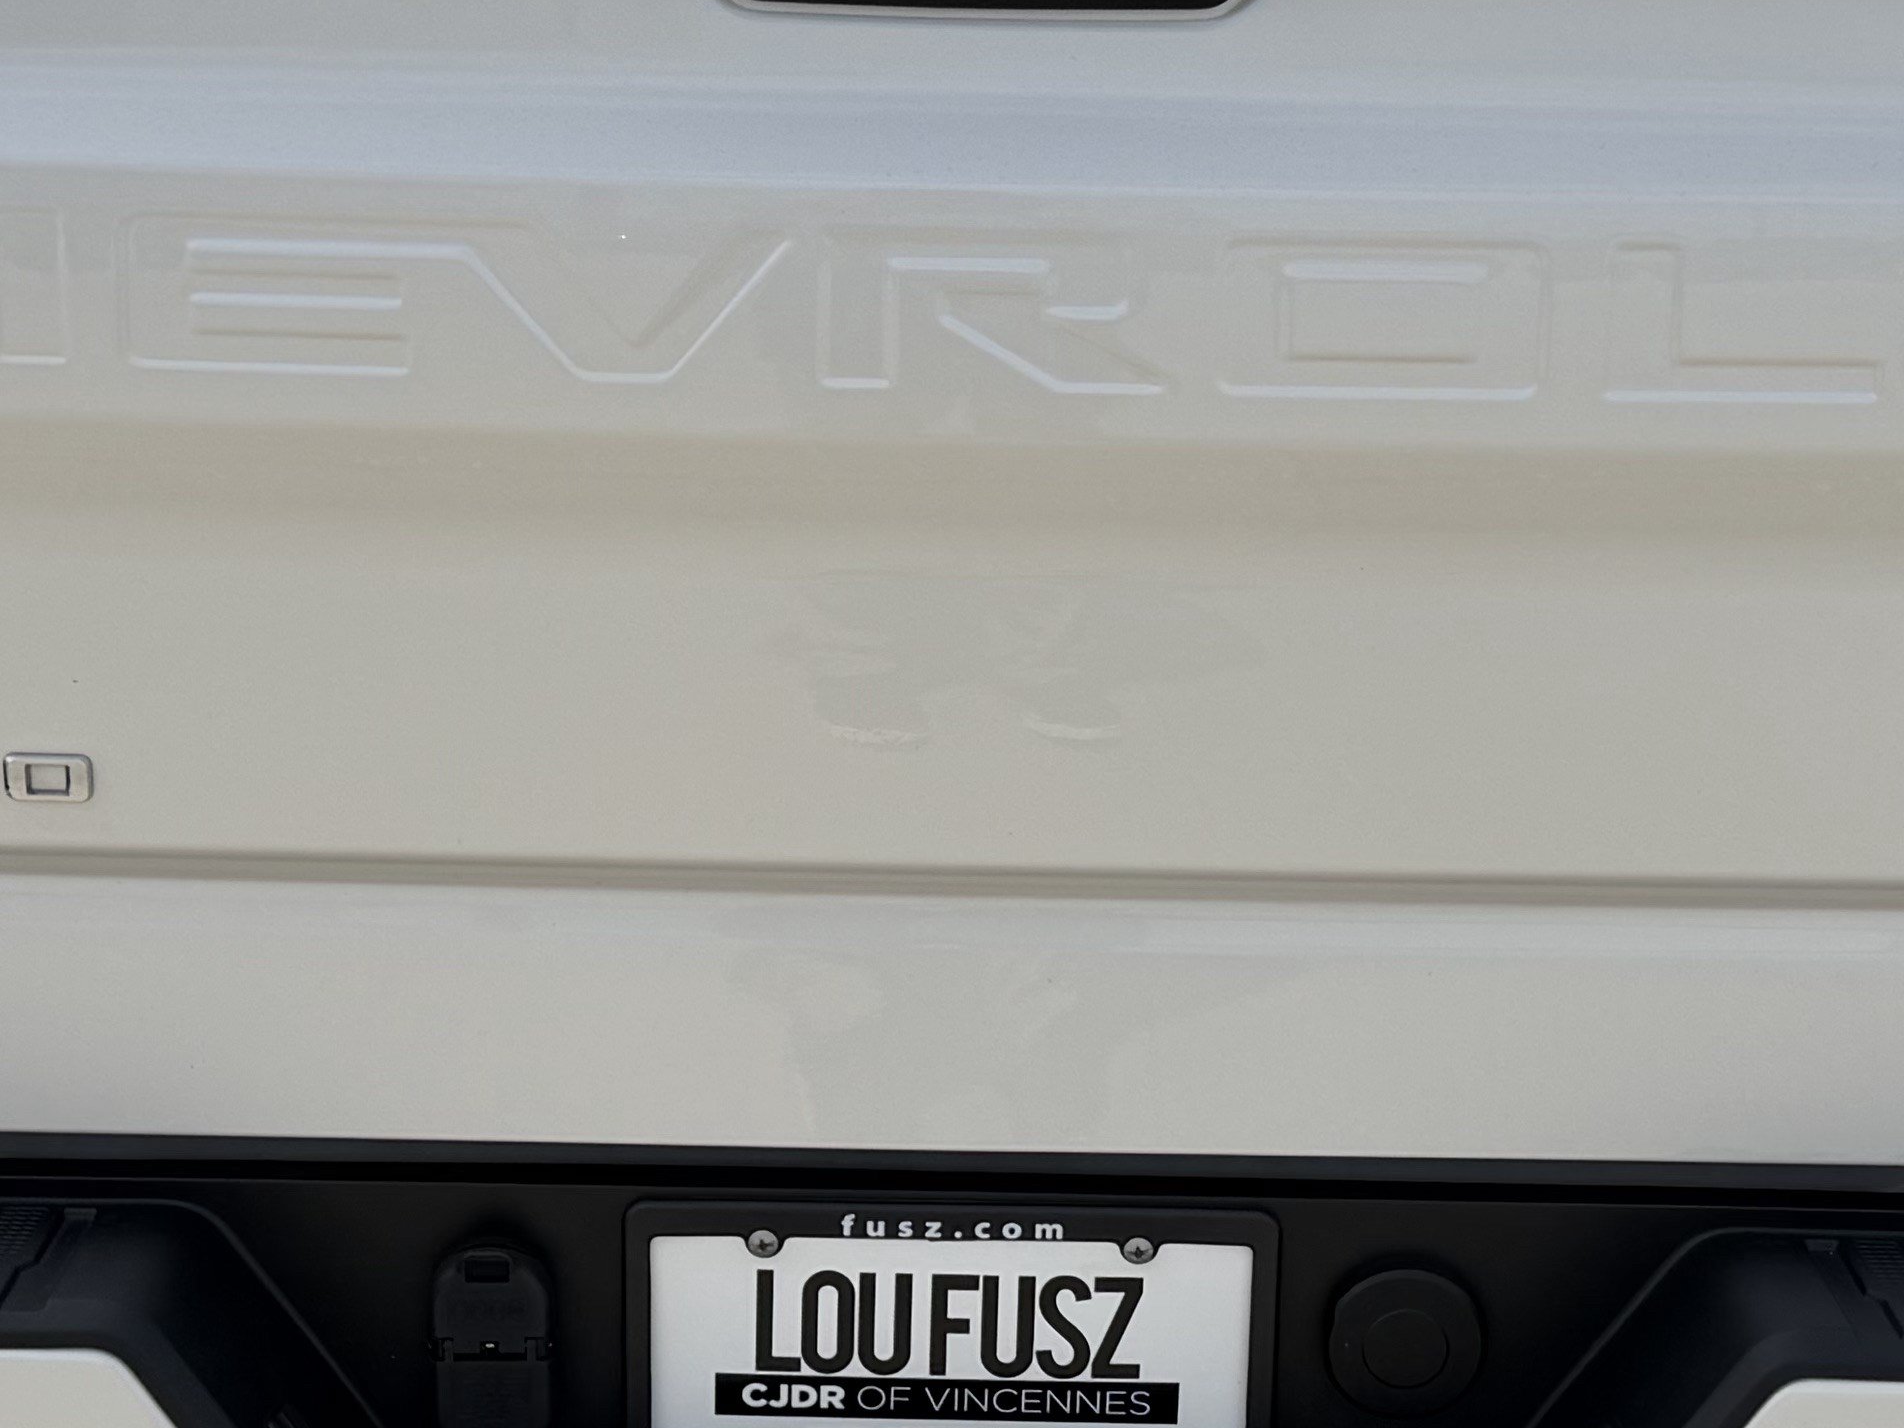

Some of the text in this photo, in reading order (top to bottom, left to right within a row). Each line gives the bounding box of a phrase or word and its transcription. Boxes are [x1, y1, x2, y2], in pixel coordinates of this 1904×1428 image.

[841, 1213, 1064, 1240] fusz.com
[741, 1382, 1152, 1416] CJDR OF VINCENNES
